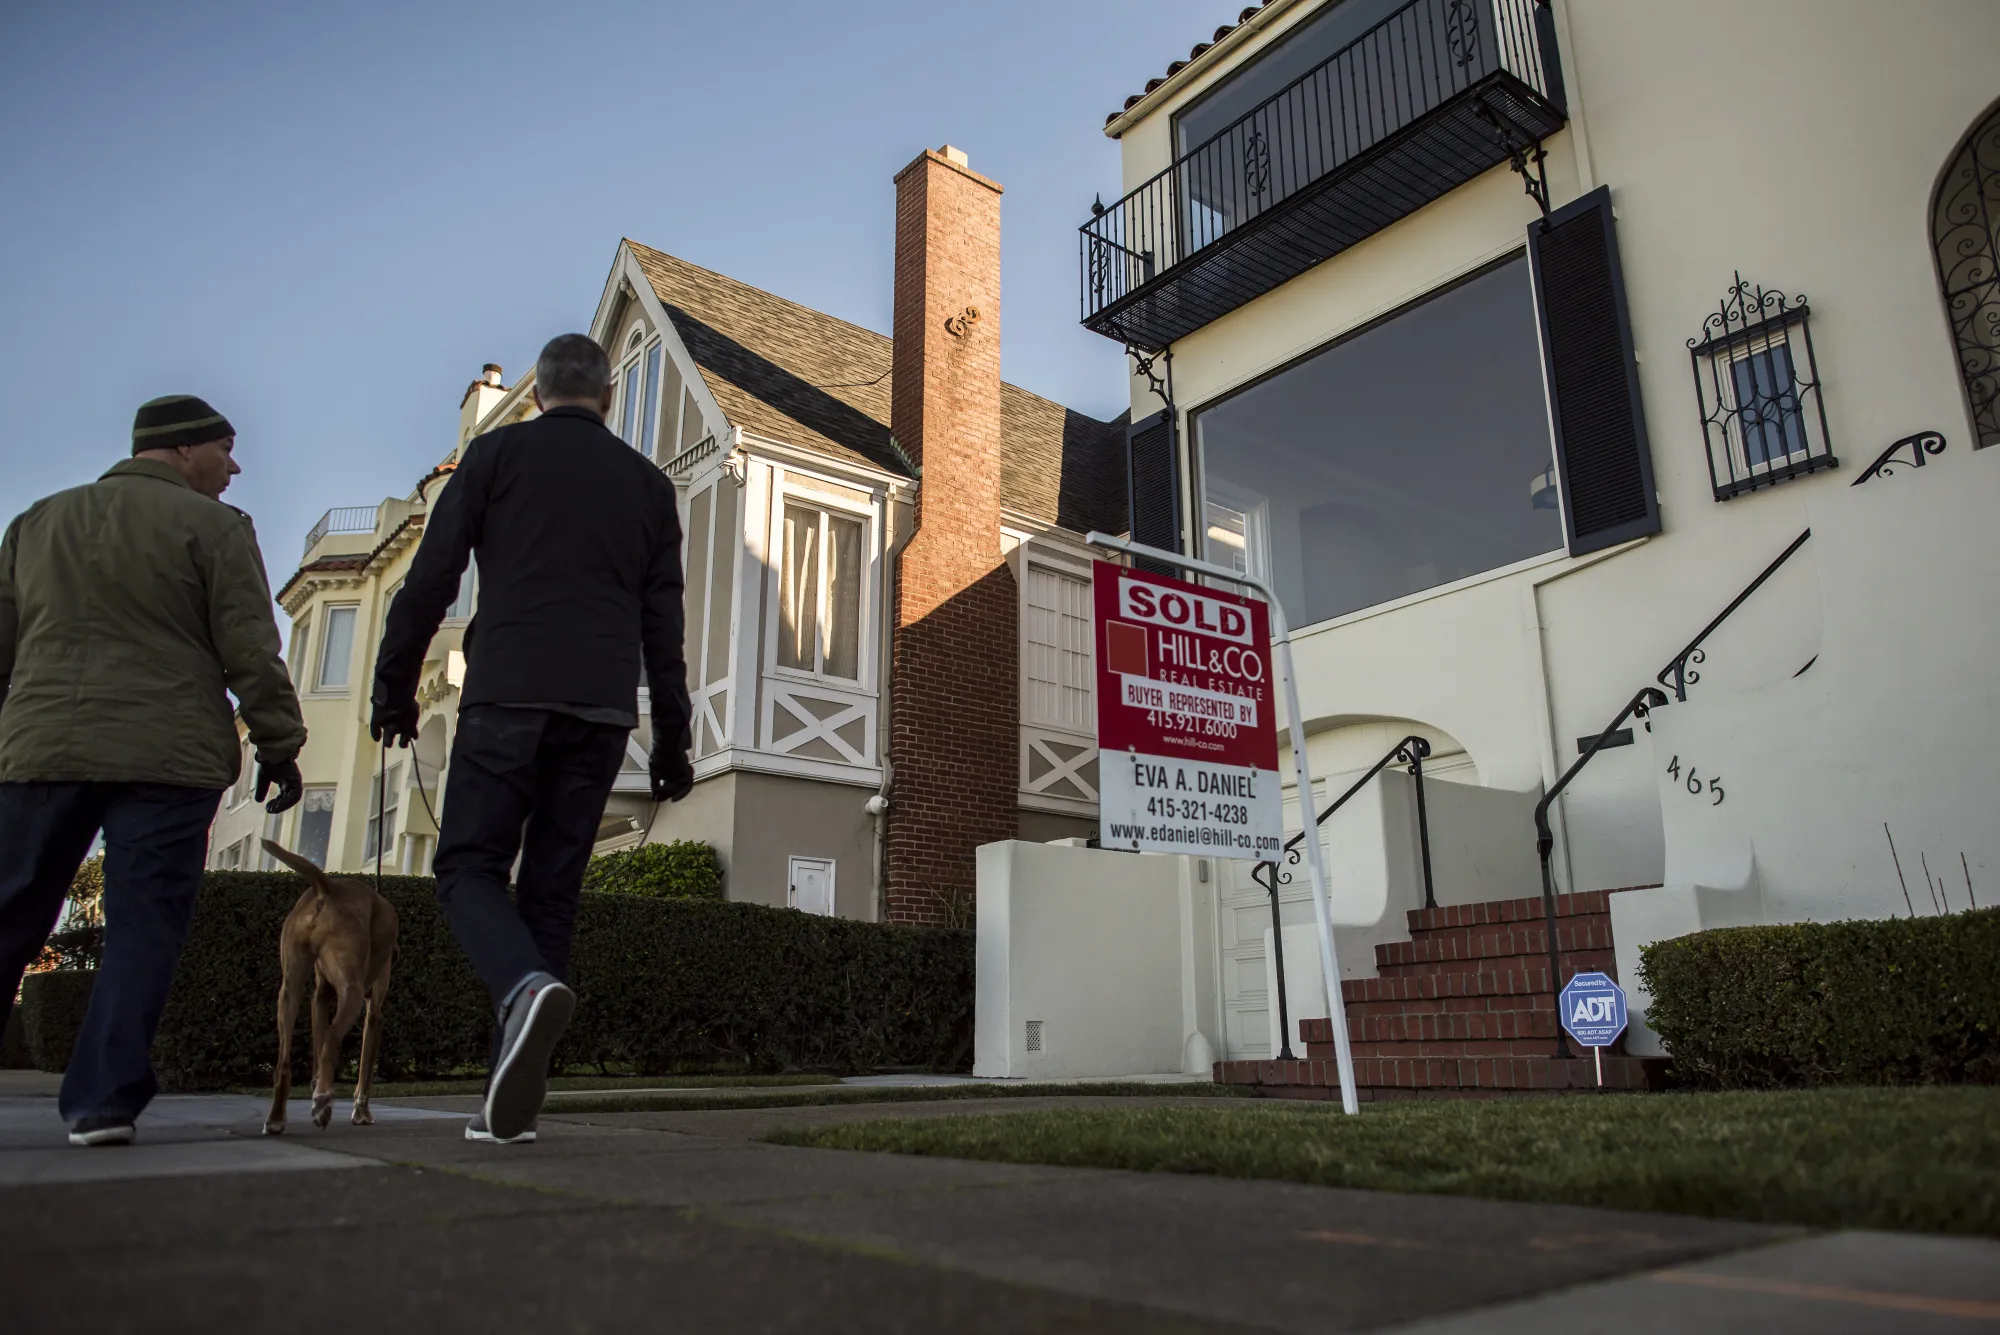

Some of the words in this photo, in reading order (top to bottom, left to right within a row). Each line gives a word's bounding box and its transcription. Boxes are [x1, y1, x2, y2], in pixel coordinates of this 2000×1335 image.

[1128, 585, 1246, 637] SOLD
[1160, 668, 1200, 688] REAL
[1208, 678, 1263, 701] ESTATE
[1128, 684, 1163, 708] BUYER
[1169, 691, 1235, 720] REPRESENTED
[1240, 705, 1252, 723] BY
[1147, 709, 1238, 739] 415.921.6000
[1162, 735, 1225, 752] www.hill-co.com
[1134, 763, 1169, 790] EVA
[1175, 768, 1192, 792] A.
[1198, 770, 1257, 799] DANIEL
[1666, 754, 1725, 806] 465
[1147, 796, 1248, 825] 415-321-4238
[1110, 823, 1280, 851] www.edaniel@hill-co.com
[1599, 979, 1606, 987] by
[1572, 996, 1615, 1023] ADT
